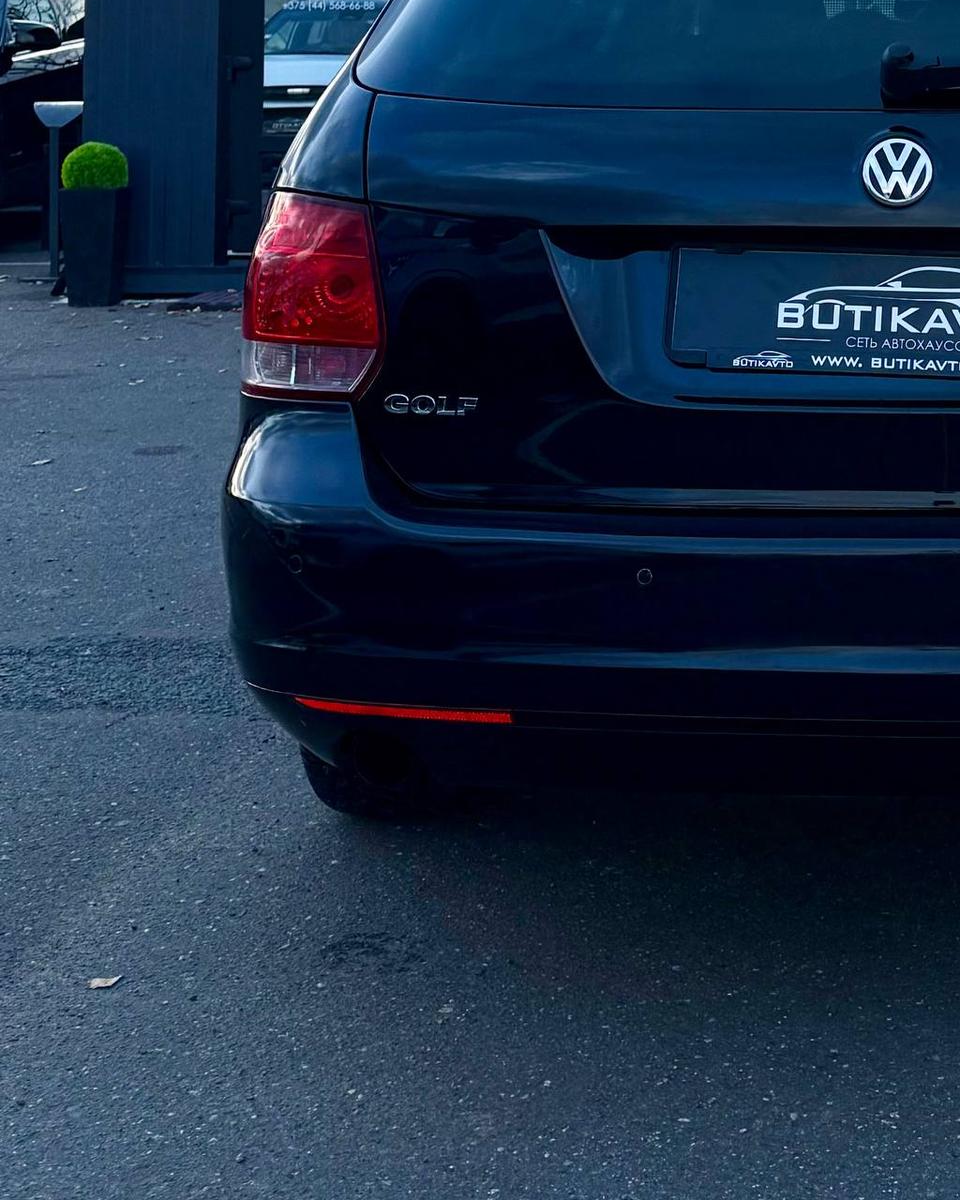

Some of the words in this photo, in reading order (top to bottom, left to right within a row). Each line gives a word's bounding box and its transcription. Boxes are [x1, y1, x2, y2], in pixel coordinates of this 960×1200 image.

[308, 1, 326, 12] (44)
[863, 138, 933, 205] VW
[845, 335, 879, 350] СЕТЬ
[732, 357, 794, 368] BUTIKAVTO
[811, 355, 863, 368] WWW.
[383, 393, 479, 416] GOLF
